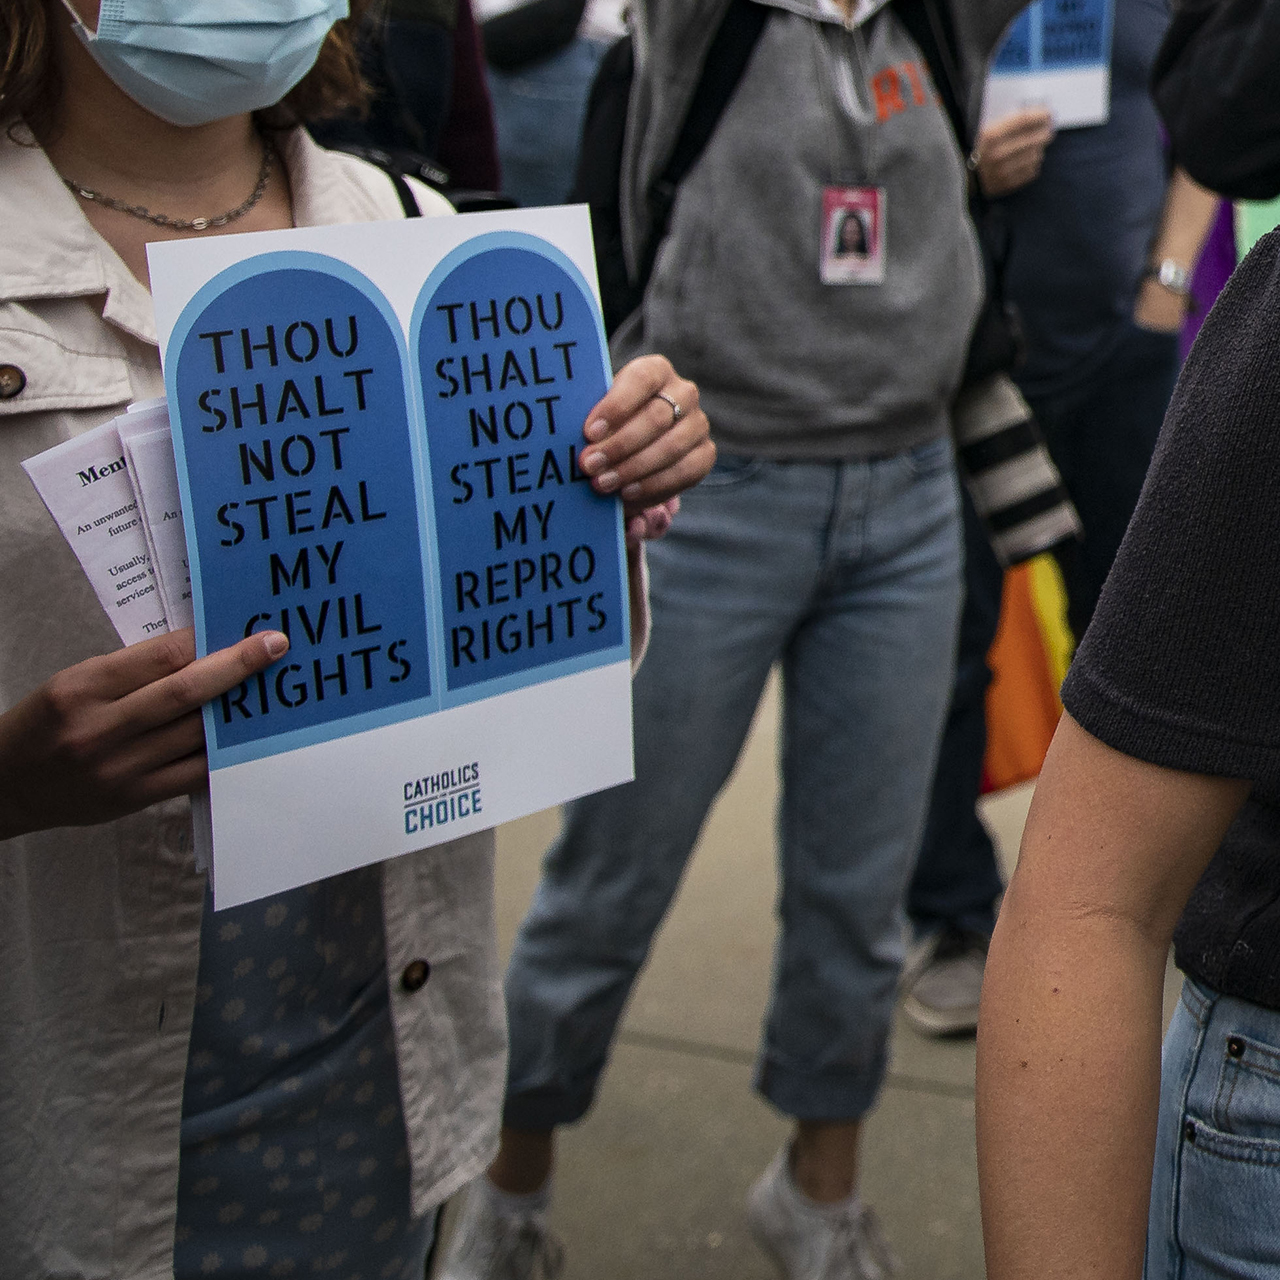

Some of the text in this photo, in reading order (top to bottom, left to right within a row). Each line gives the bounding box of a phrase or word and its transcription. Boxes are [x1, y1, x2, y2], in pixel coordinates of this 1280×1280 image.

[872, 59, 943, 124] RI
[436, 291, 566, 344] THOU
[200, 315, 361, 375] THOU
[435, 340, 579, 399] SHALT
[198, 368, 376, 432] SHALT
[468, 396, 562, 448] NOT
[76, 455, 128, 488] Ment
[238, 428, 351, 486] NOT
[450, 444, 591, 506] STEAL
[77, 524, 92, 536] An
[108, 518, 138, 537] future
[217, 480, 388, 548] STEAL
[493, 500, 556, 551] MY
[108, 553, 151, 578] Usually,
[116, 574, 147, 592] access
[269, 540, 346, 598] MY
[454, 544, 598, 612] REPRO
[116, 584, 156, 609] services
[142, 617, 169, 635] Thes
[450, 592, 609, 669] RIGHTS
[220, 639, 412, 725] RIGHTS
[403, 761, 480, 802] CATHOLICS
[404, 789, 483, 836] CHOICE
